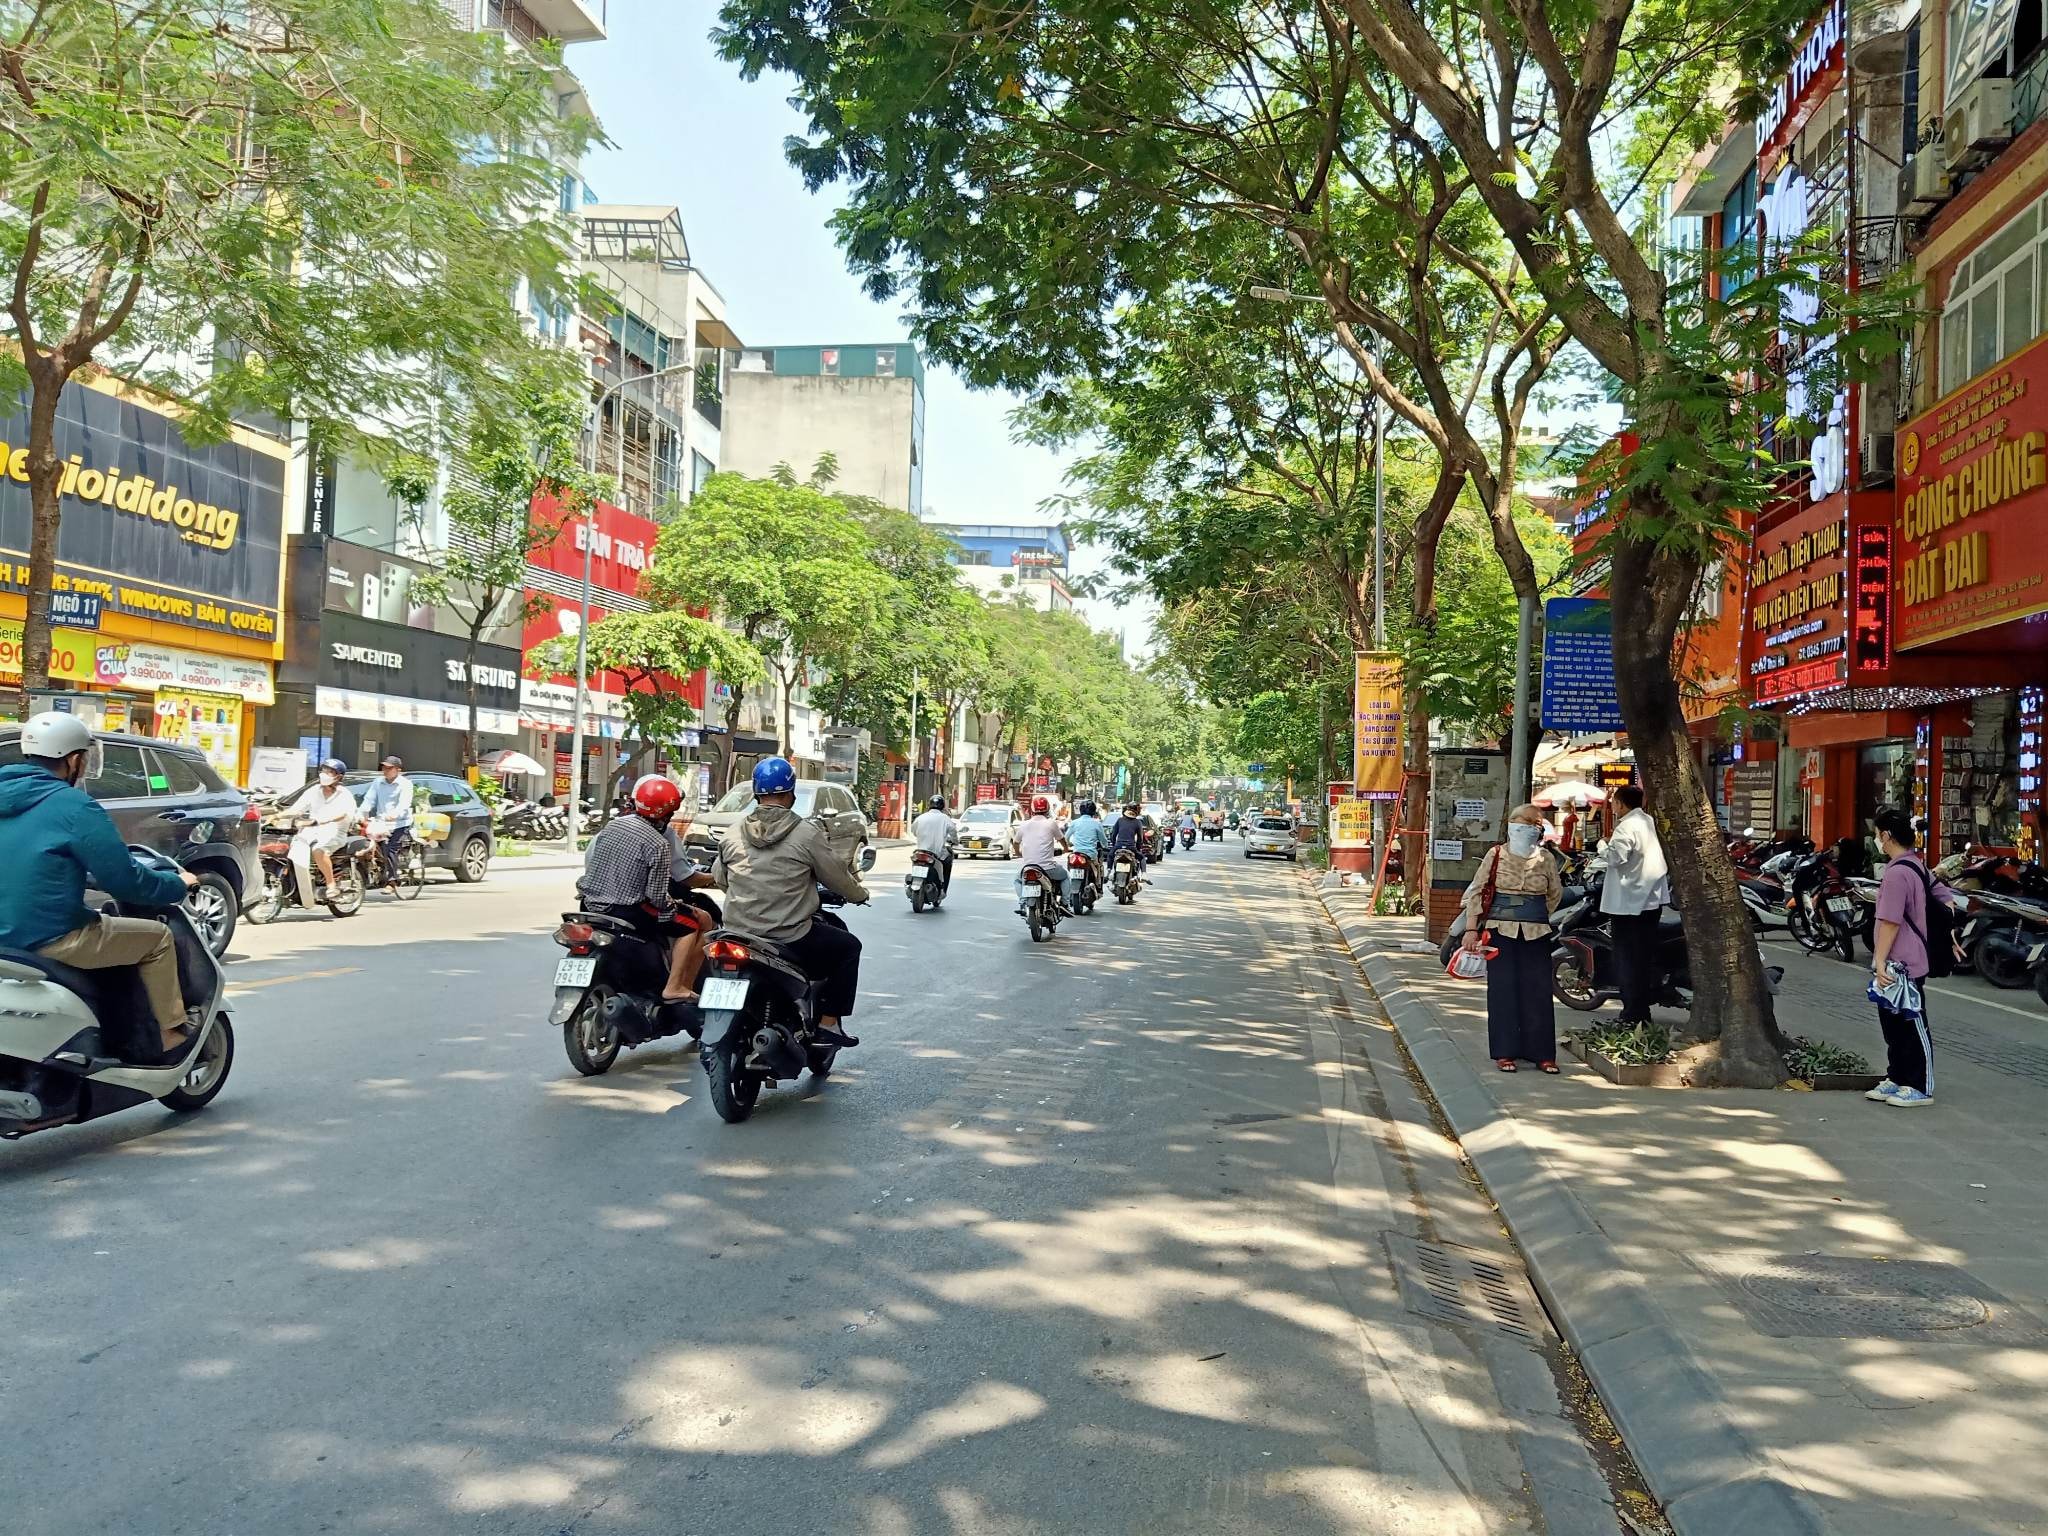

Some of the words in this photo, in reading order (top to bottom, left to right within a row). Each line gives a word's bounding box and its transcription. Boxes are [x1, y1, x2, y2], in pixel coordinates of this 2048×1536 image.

[1791, 0, 1840, 101] THOẠI
[1904, 474, 1953, 543] CÔNG
[1958, 431, 2045, 518] CHỨNG
[614, 540, 646, 571] TRẢ
[1790, 533, 1811, 574] ĐIỆN
[1812, 521, 1841, 559] THOẠI
[1904, 537, 1942, 607] ĐẤT
[1945, 531, 1986, 593] ĐAI
[52, 592, 82, 615] NGÕ
[83, 597, 98, 616] 11
[119, 587, 194, 618] WINDOWS
[196, 602, 227, 625] BẢN
[229, 609, 274, 635] QUYỀN
[1769, 591, 1789, 629] KIỆN
[1789, 580, 1810, 621] ĐIỆN
[1811, 573, 1839, 610] THOẠI
[331, 643, 403, 669] SAMCENTER
[1808, 756, 1818, 773] 66
